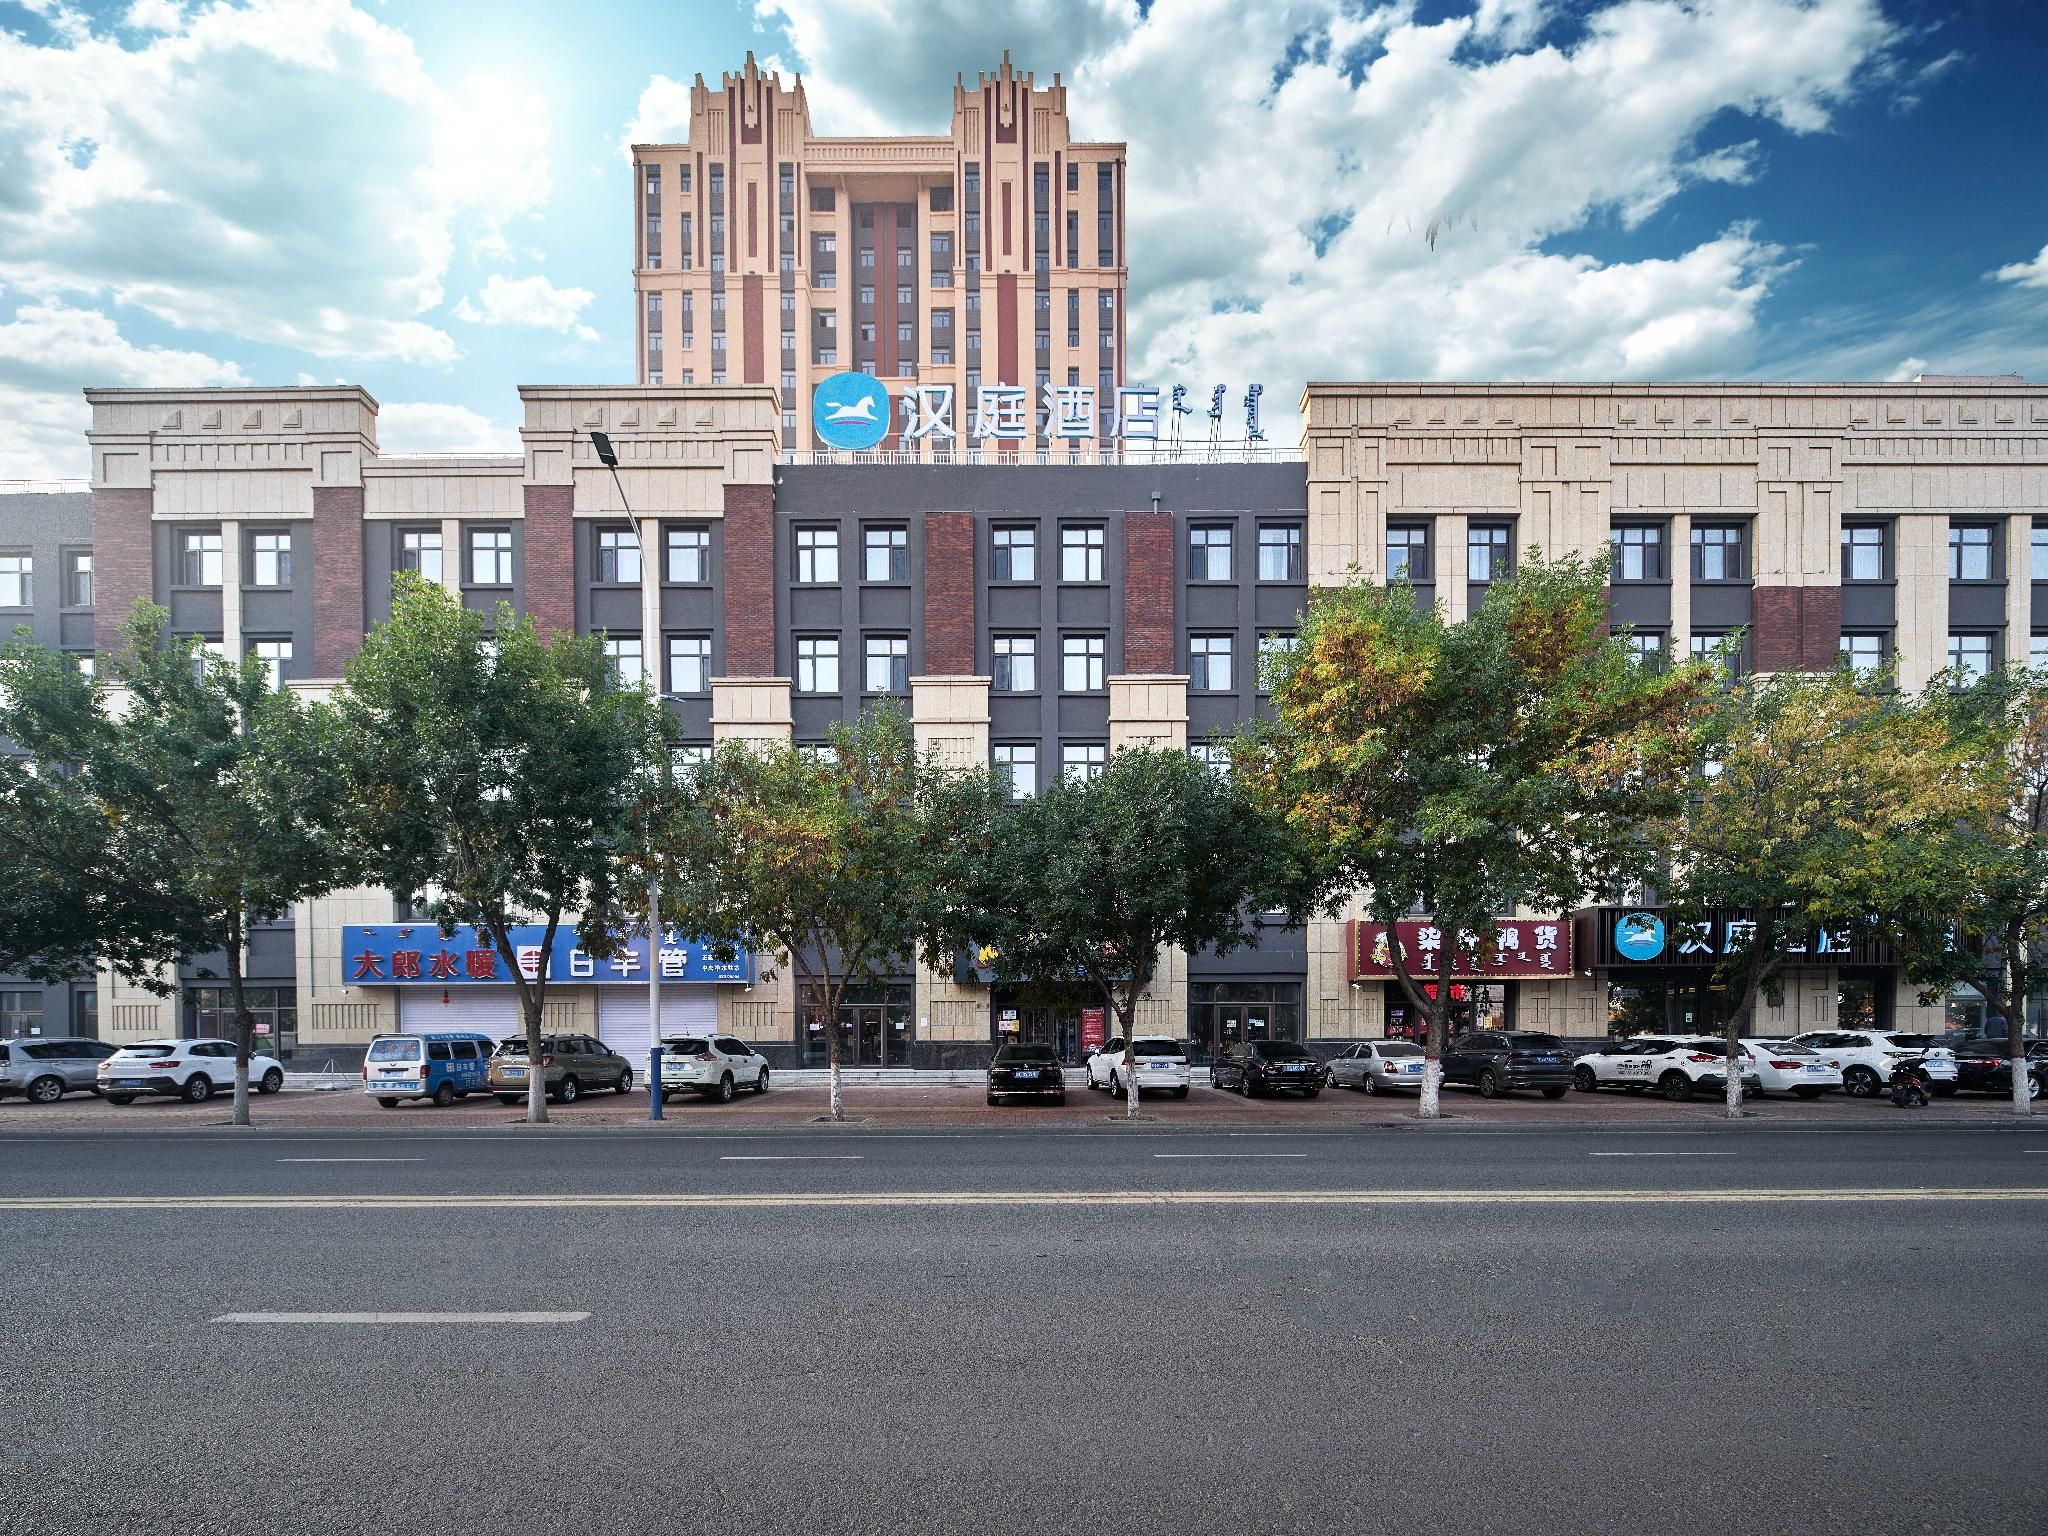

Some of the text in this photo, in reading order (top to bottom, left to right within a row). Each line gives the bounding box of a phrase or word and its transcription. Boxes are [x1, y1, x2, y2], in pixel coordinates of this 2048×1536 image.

[903, 382, 1160, 439] 汉庭酒店
[1678, 919, 1851, 953] 汉庭店
[353, 948, 497, 979] 大郎水暖
[569, 947, 688, 977] 日丰管
